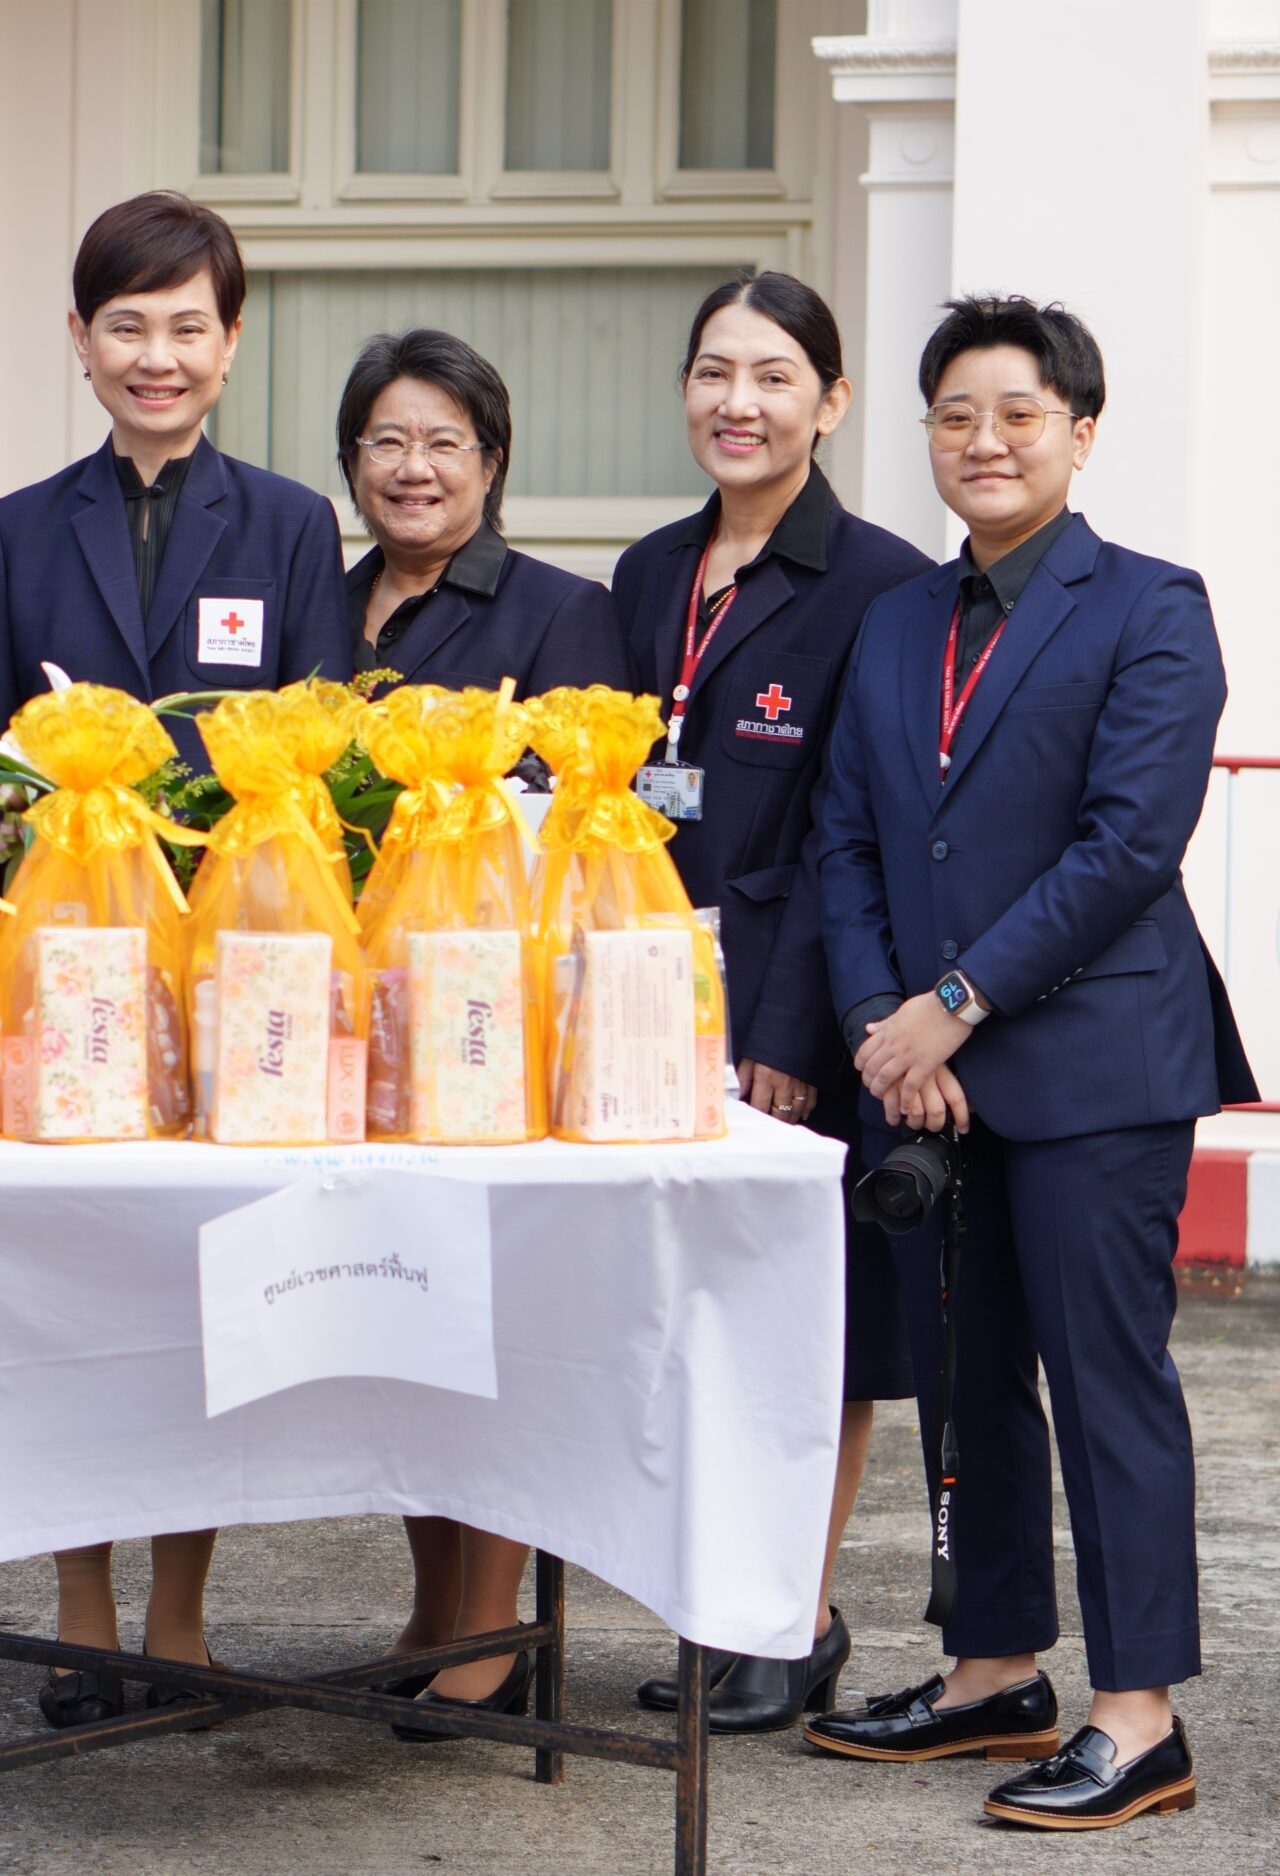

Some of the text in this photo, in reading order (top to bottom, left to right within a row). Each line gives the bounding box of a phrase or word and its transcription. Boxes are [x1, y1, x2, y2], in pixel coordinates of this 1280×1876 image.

[736, 720, 803, 736] สภากาชาดไทย
[92, 997, 117, 1065] festa
[258, 1009, 285, 1077] festa
[339, 1043, 357, 1084] LUX
[467, 999, 493, 1067] festa
[263, 1252, 428, 1304] ศูนย์เวชศาสตร์ฟื้นฟู
[937, 1490, 950, 1561] SONY
